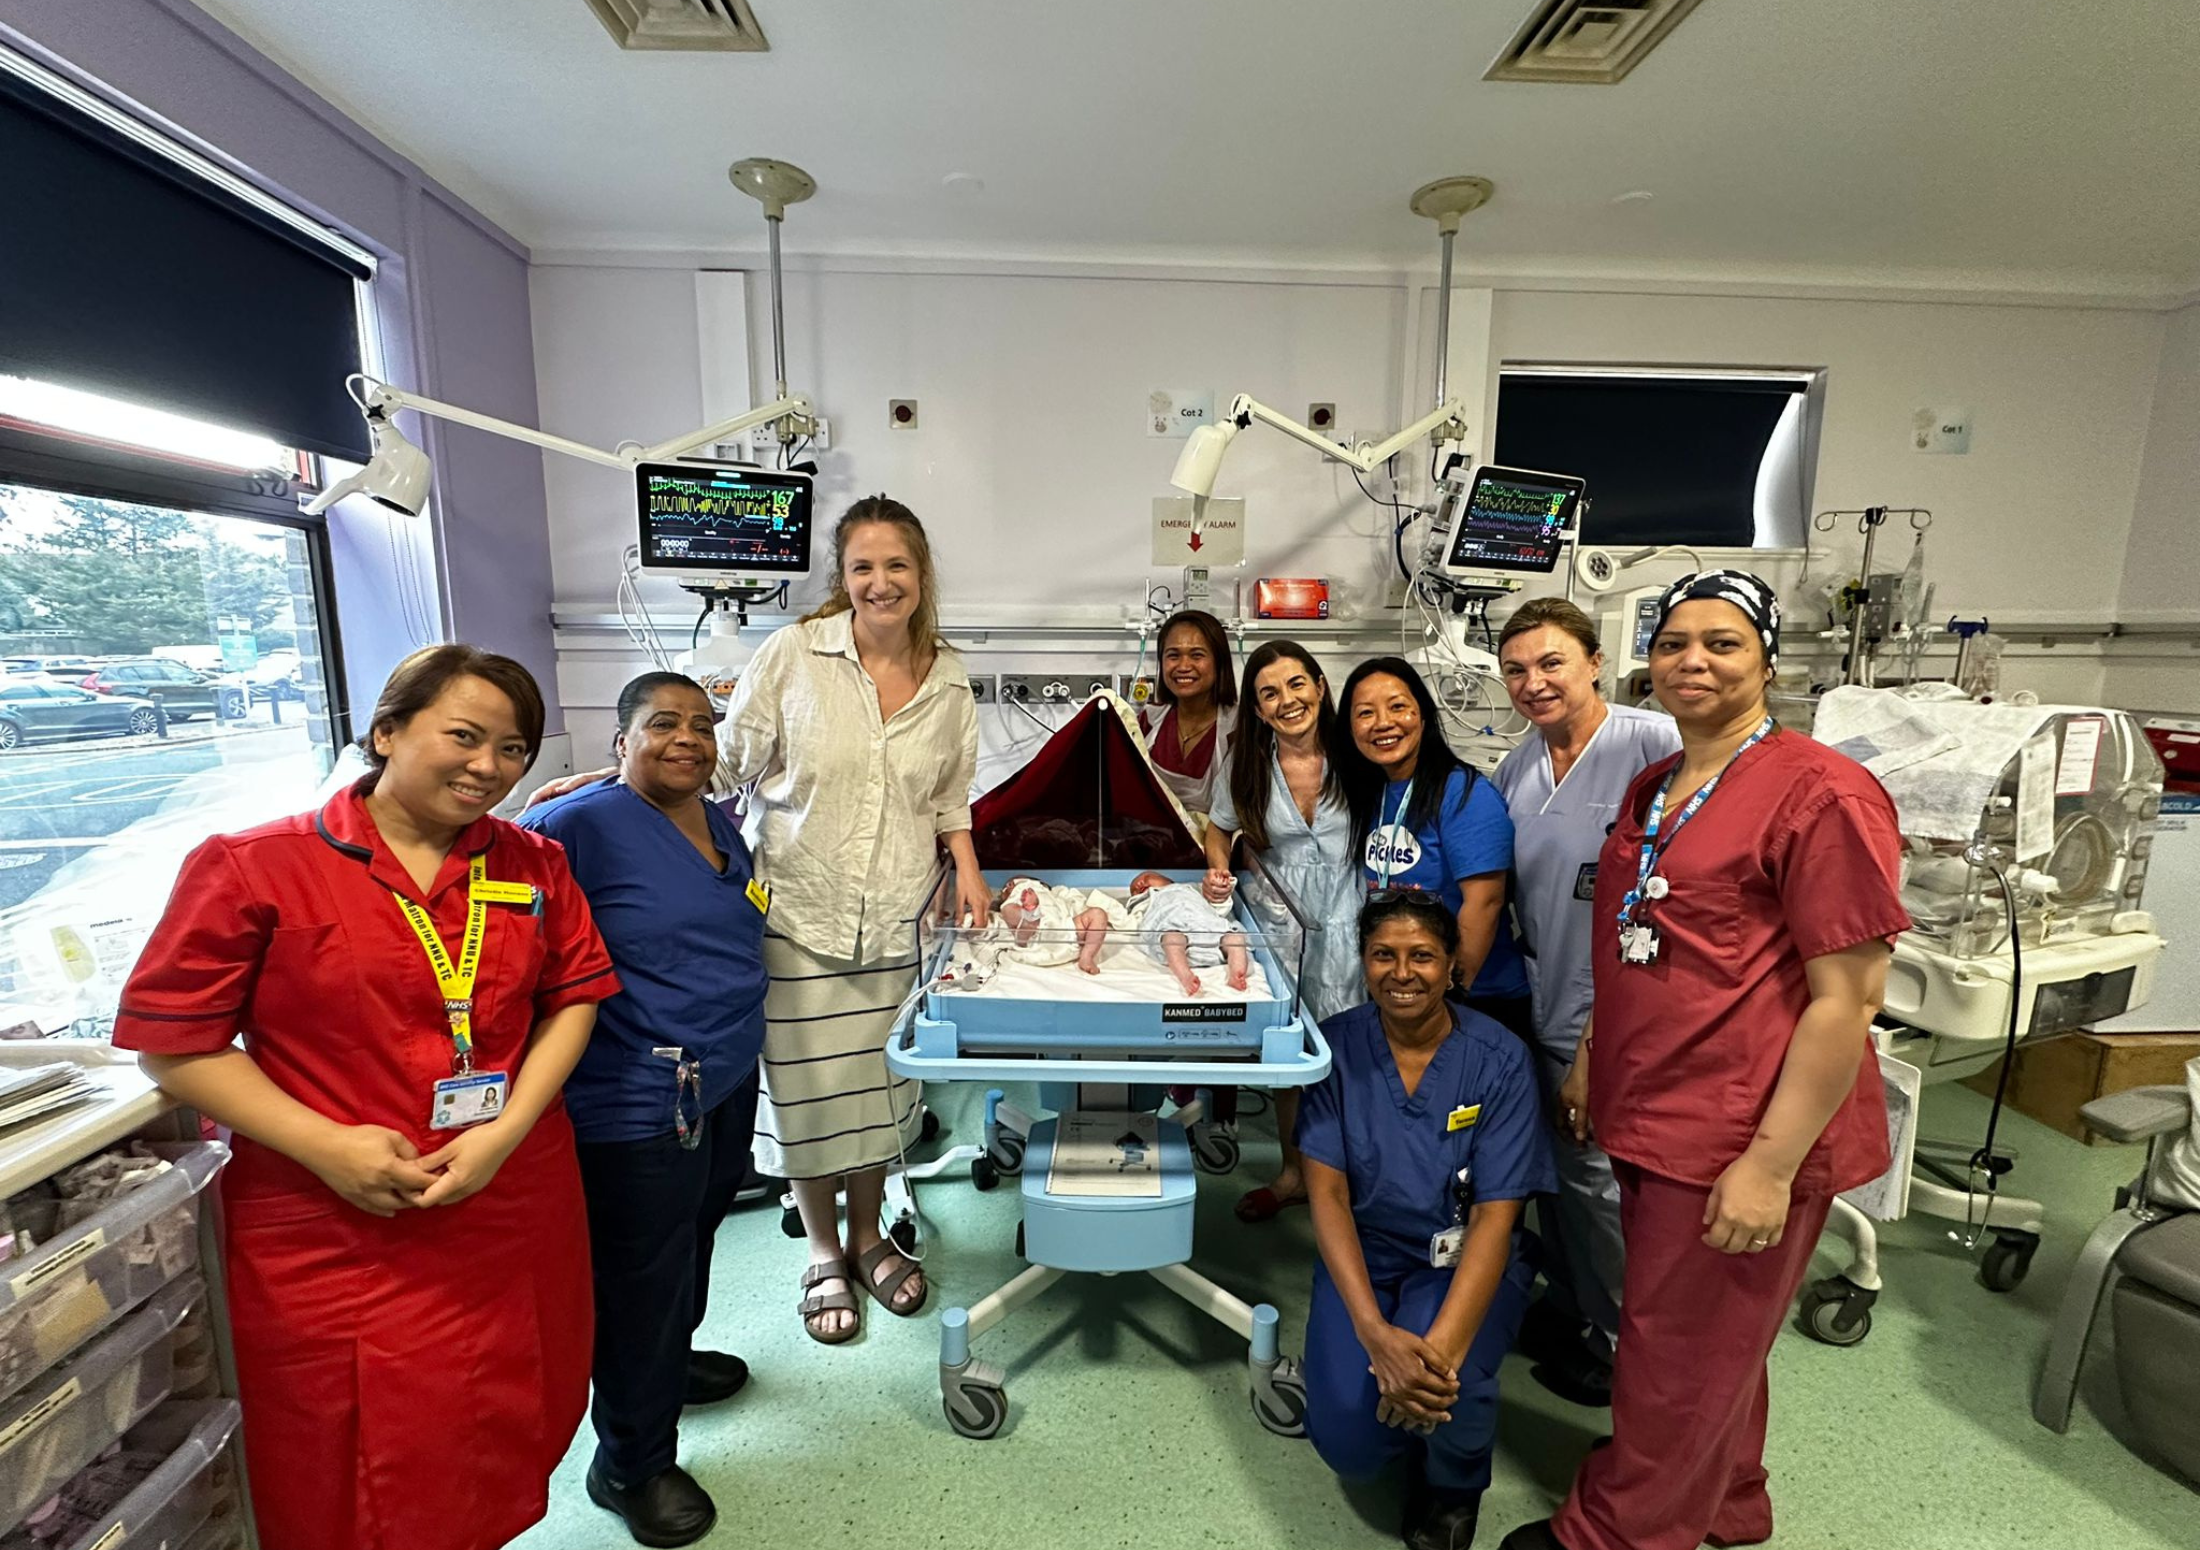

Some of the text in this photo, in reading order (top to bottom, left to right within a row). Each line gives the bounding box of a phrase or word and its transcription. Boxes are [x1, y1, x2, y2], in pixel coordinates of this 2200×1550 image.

[1181, 408, 1203, 417] Cot 2
[771, 490, 795, 505] 167
[772, 504, 790, 519] 53
[1160, 520, 1236, 529] EMERGEY ALARM
[1685, 794, 1703, 815] NHS
[2162, 801, 2193, 811] BCOLD
[1650, 810, 1662, 826] NHS
[1367, 844, 1414, 864] Pcles
[473, 899, 483, 922] atron
[469, 924, 481, 937] for
[403, 899, 427, 930] Matron
[422, 929, 434, 943] for
[429, 943, 444, 961] NNU
[440, 969, 453, 981] TC
[466, 938, 479, 957] NNU
[461, 967, 473, 978] TC
[447, 1001, 469, 1009] NHS
[1204, 1008, 1243, 1017] BABYBED
